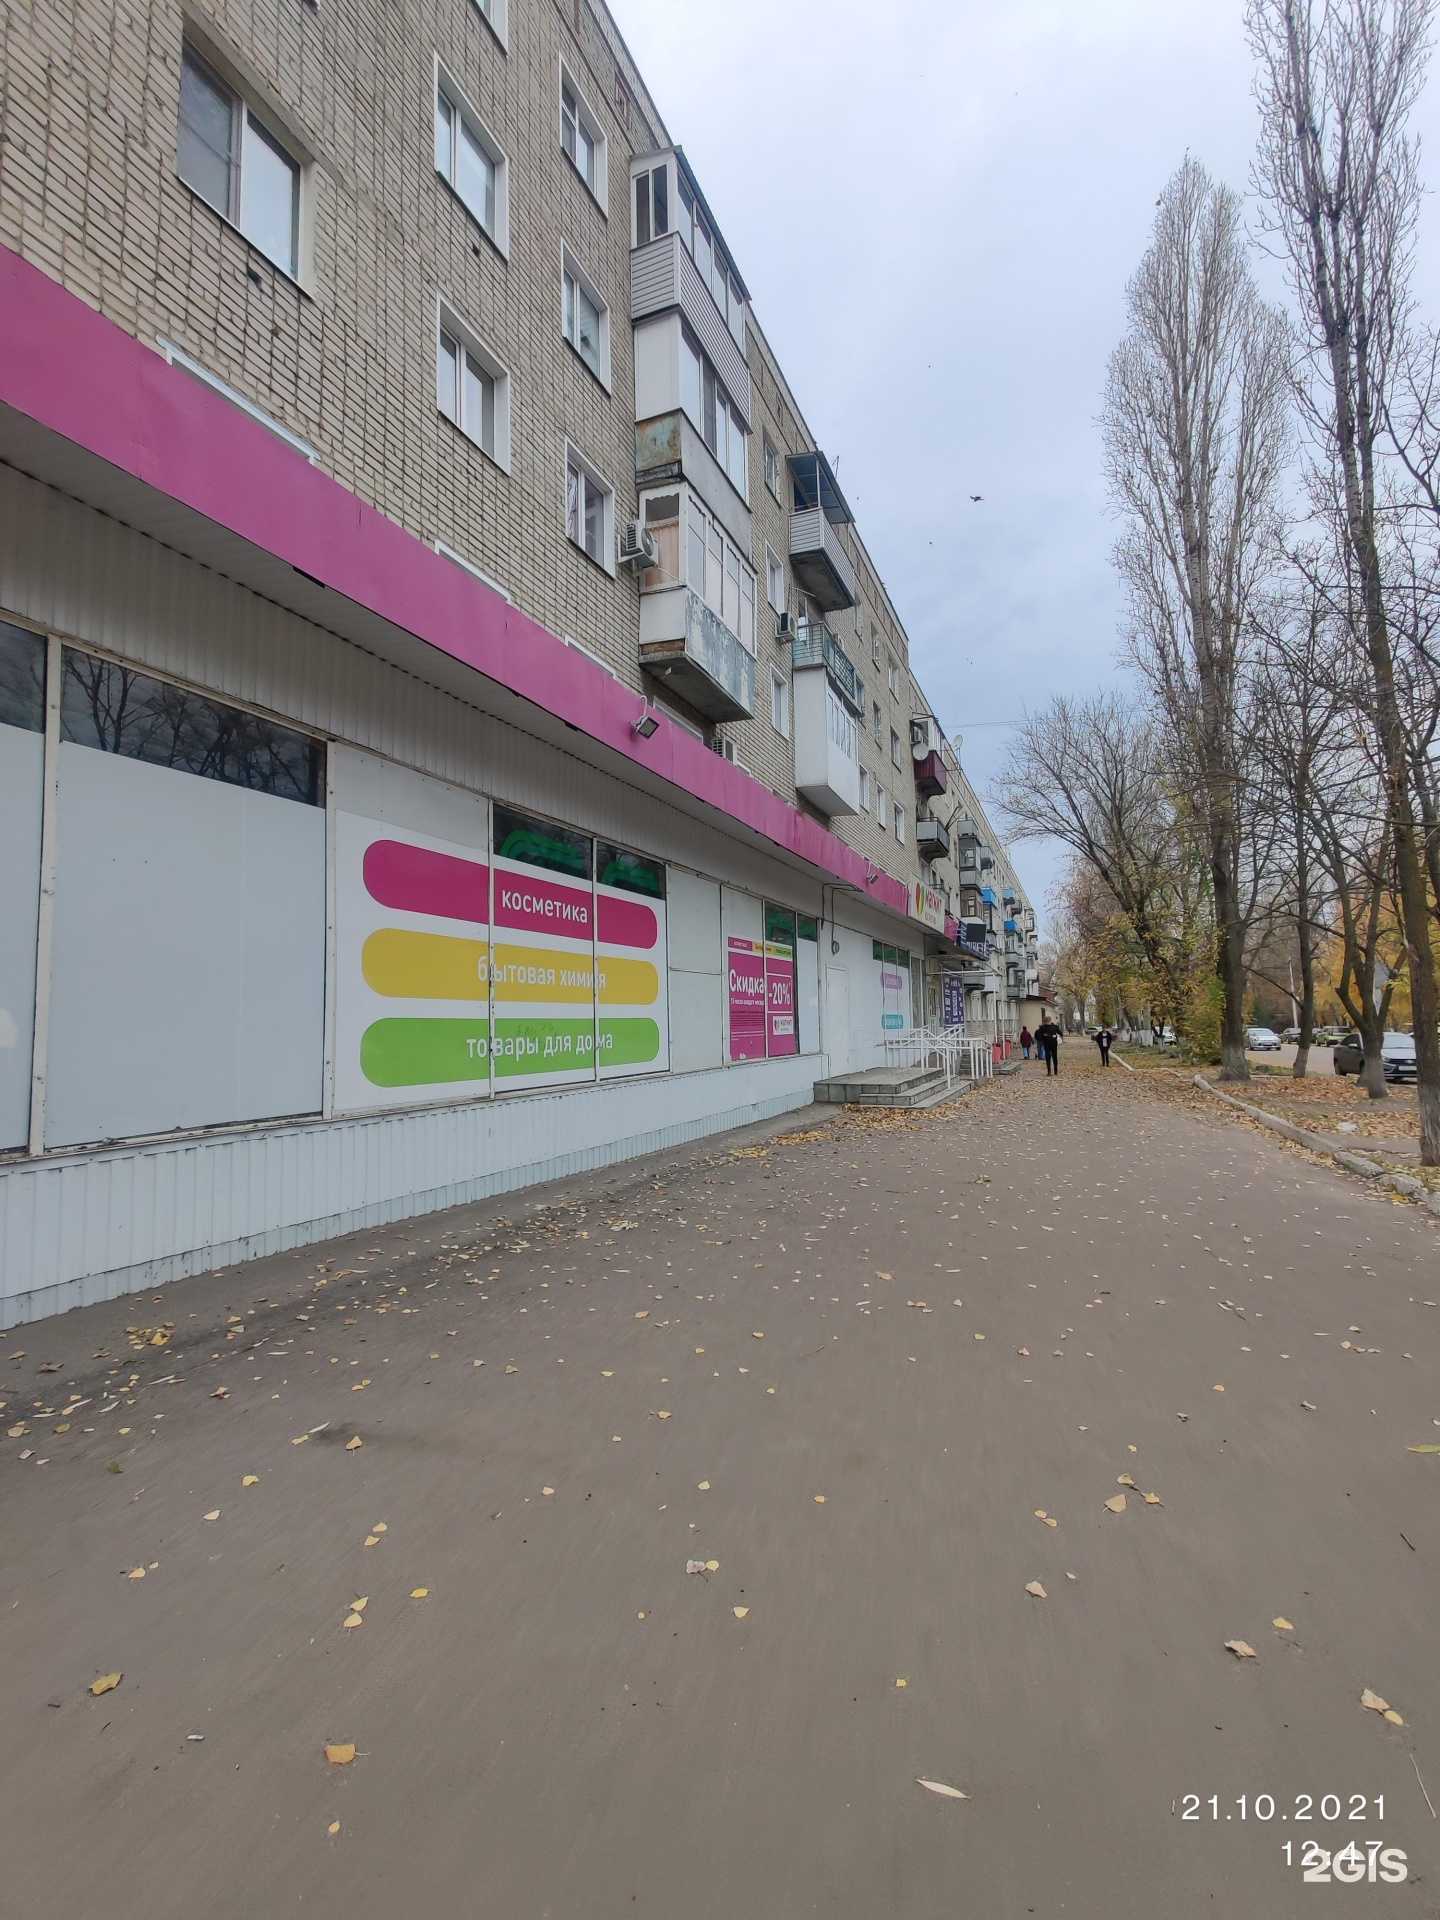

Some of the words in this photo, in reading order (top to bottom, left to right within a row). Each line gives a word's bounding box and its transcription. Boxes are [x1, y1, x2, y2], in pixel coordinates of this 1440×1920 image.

[502, 889, 588, 924] косметика
[478, 955, 556, 985] бытовая
[560, 968, 606, 989] химия
[729, 968, 765, 998] Скидка
[466, 1036, 539, 1062] товары
[543, 1035, 572, 1058] для
[576, 1032, 613, 1055] дома
